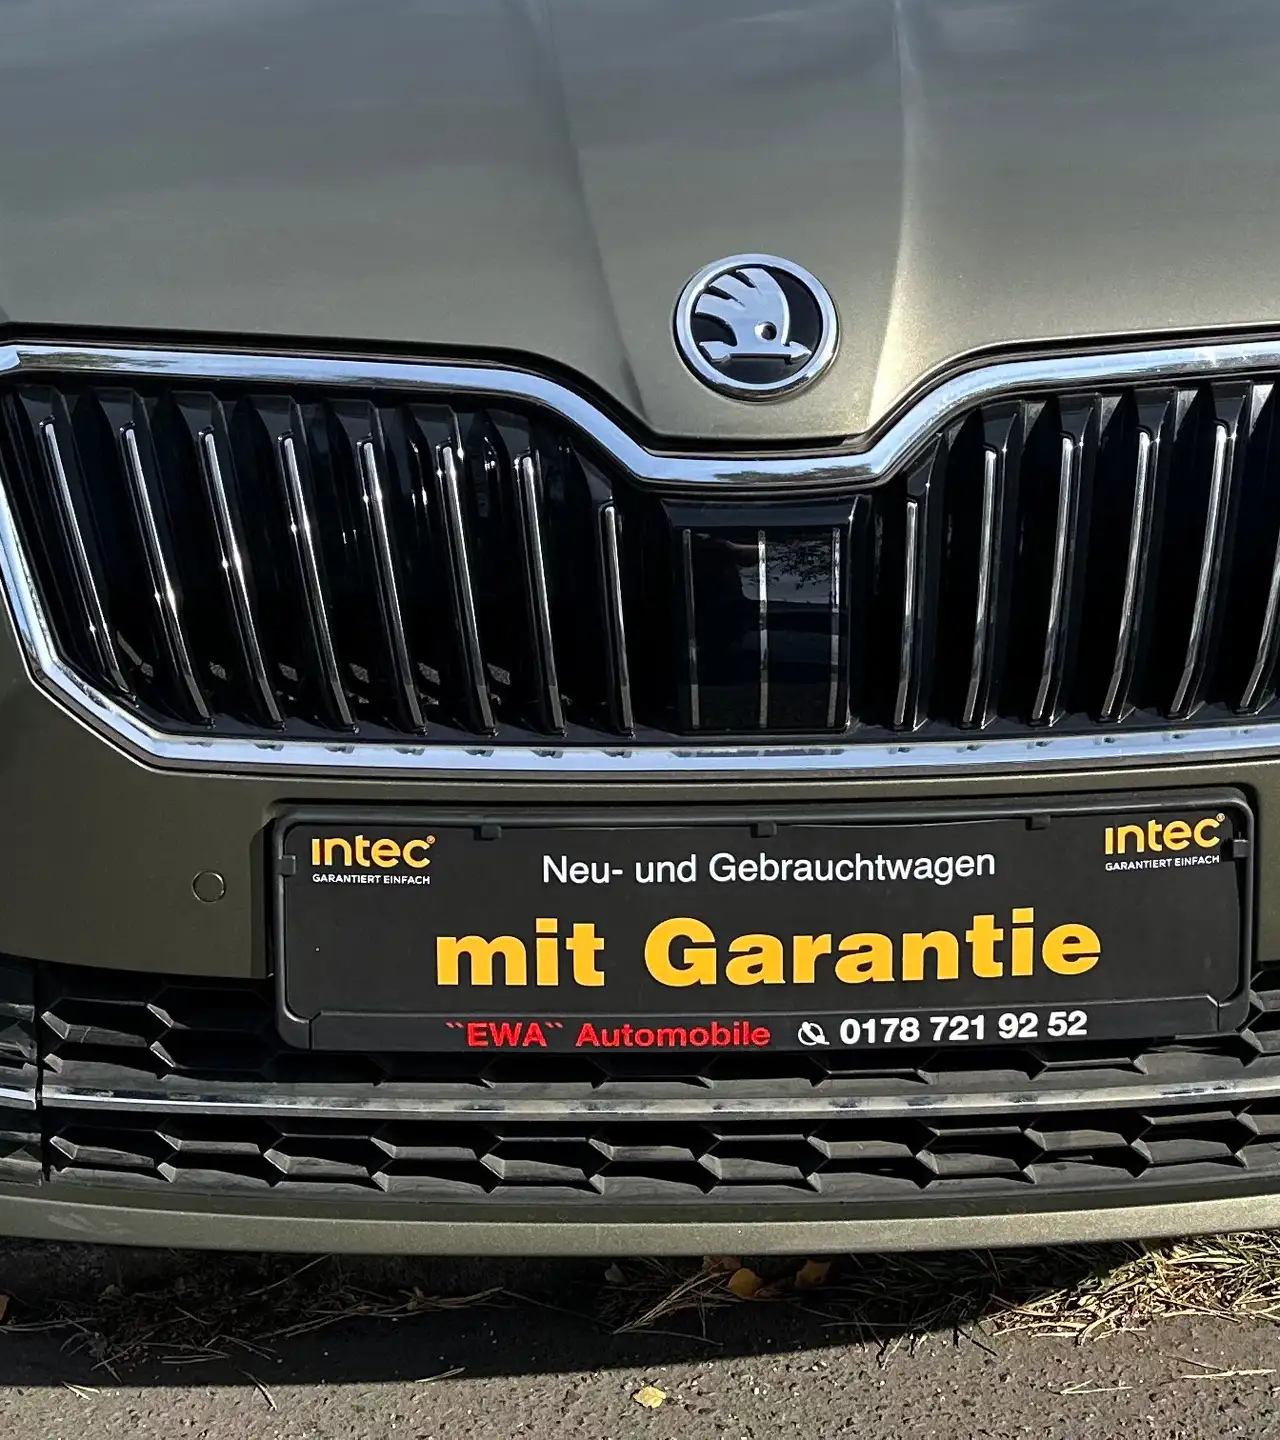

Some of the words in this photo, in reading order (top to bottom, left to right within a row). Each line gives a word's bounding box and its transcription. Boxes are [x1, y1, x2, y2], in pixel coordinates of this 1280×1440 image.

[312, 873, 381, 884] GARANTIERT
[383, 874, 431, 885] EINFACH
[542, 854, 624, 884] Neu-
[635, 853, 697, 883] und
[708, 852, 996, 886] Gebrauchtwagen
[1105, 857, 1171, 872] GARANTIERT
[1174, 854, 1220, 867] EINFACH
[436, 917, 605, 987] mit
[644, 907, 1101, 988] Garantie
[575, 1020, 771, 1048] Automobile
[839, 1017, 921, 1045] 0178
[929, 1015, 985, 1042] 721
[997, 1012, 1039, 1040] 92
[1046, 1010, 1089, 1037] 52
